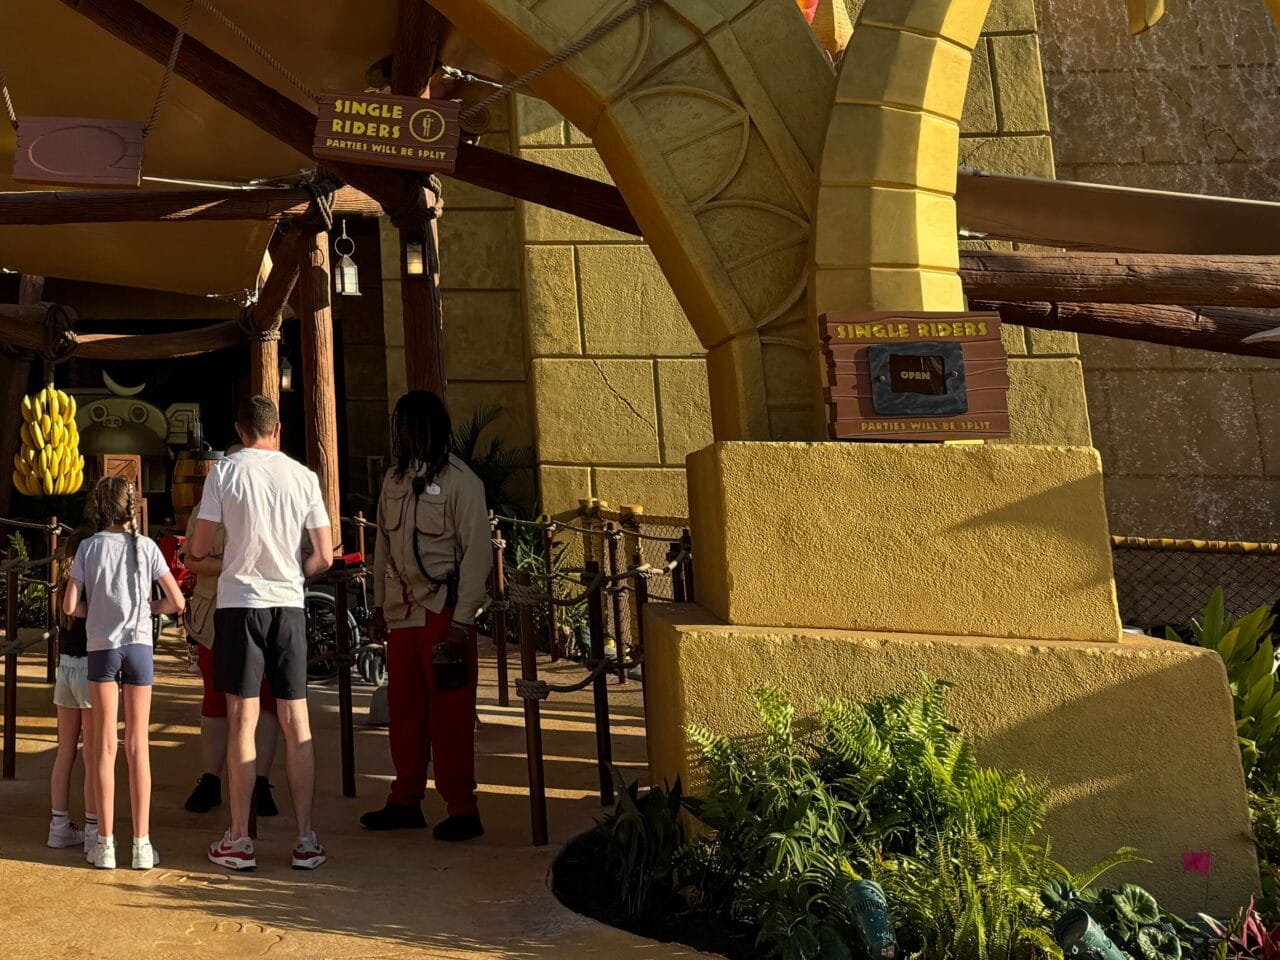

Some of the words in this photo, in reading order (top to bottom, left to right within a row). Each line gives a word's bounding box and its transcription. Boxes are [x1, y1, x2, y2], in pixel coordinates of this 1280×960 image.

[335, 100, 403, 119] SINGLE
[331, 119, 401, 139] RIDERS
[326, 139, 368, 151] PARTIES
[371, 144, 397, 154] WILL
[401, 147, 414, 156] BE
[418, 150, 446, 160] SPLIT
[837, 323, 910, 339] SINGLE
[918, 322, 988, 337] RIDERS
[900, 371, 931, 380] OPEN
[861, 422, 906, 431] PARTIES
[911, 422, 937, 431] WILL
[942, 422, 956, 430] BE
[961, 421, 991, 430] SPLIT
